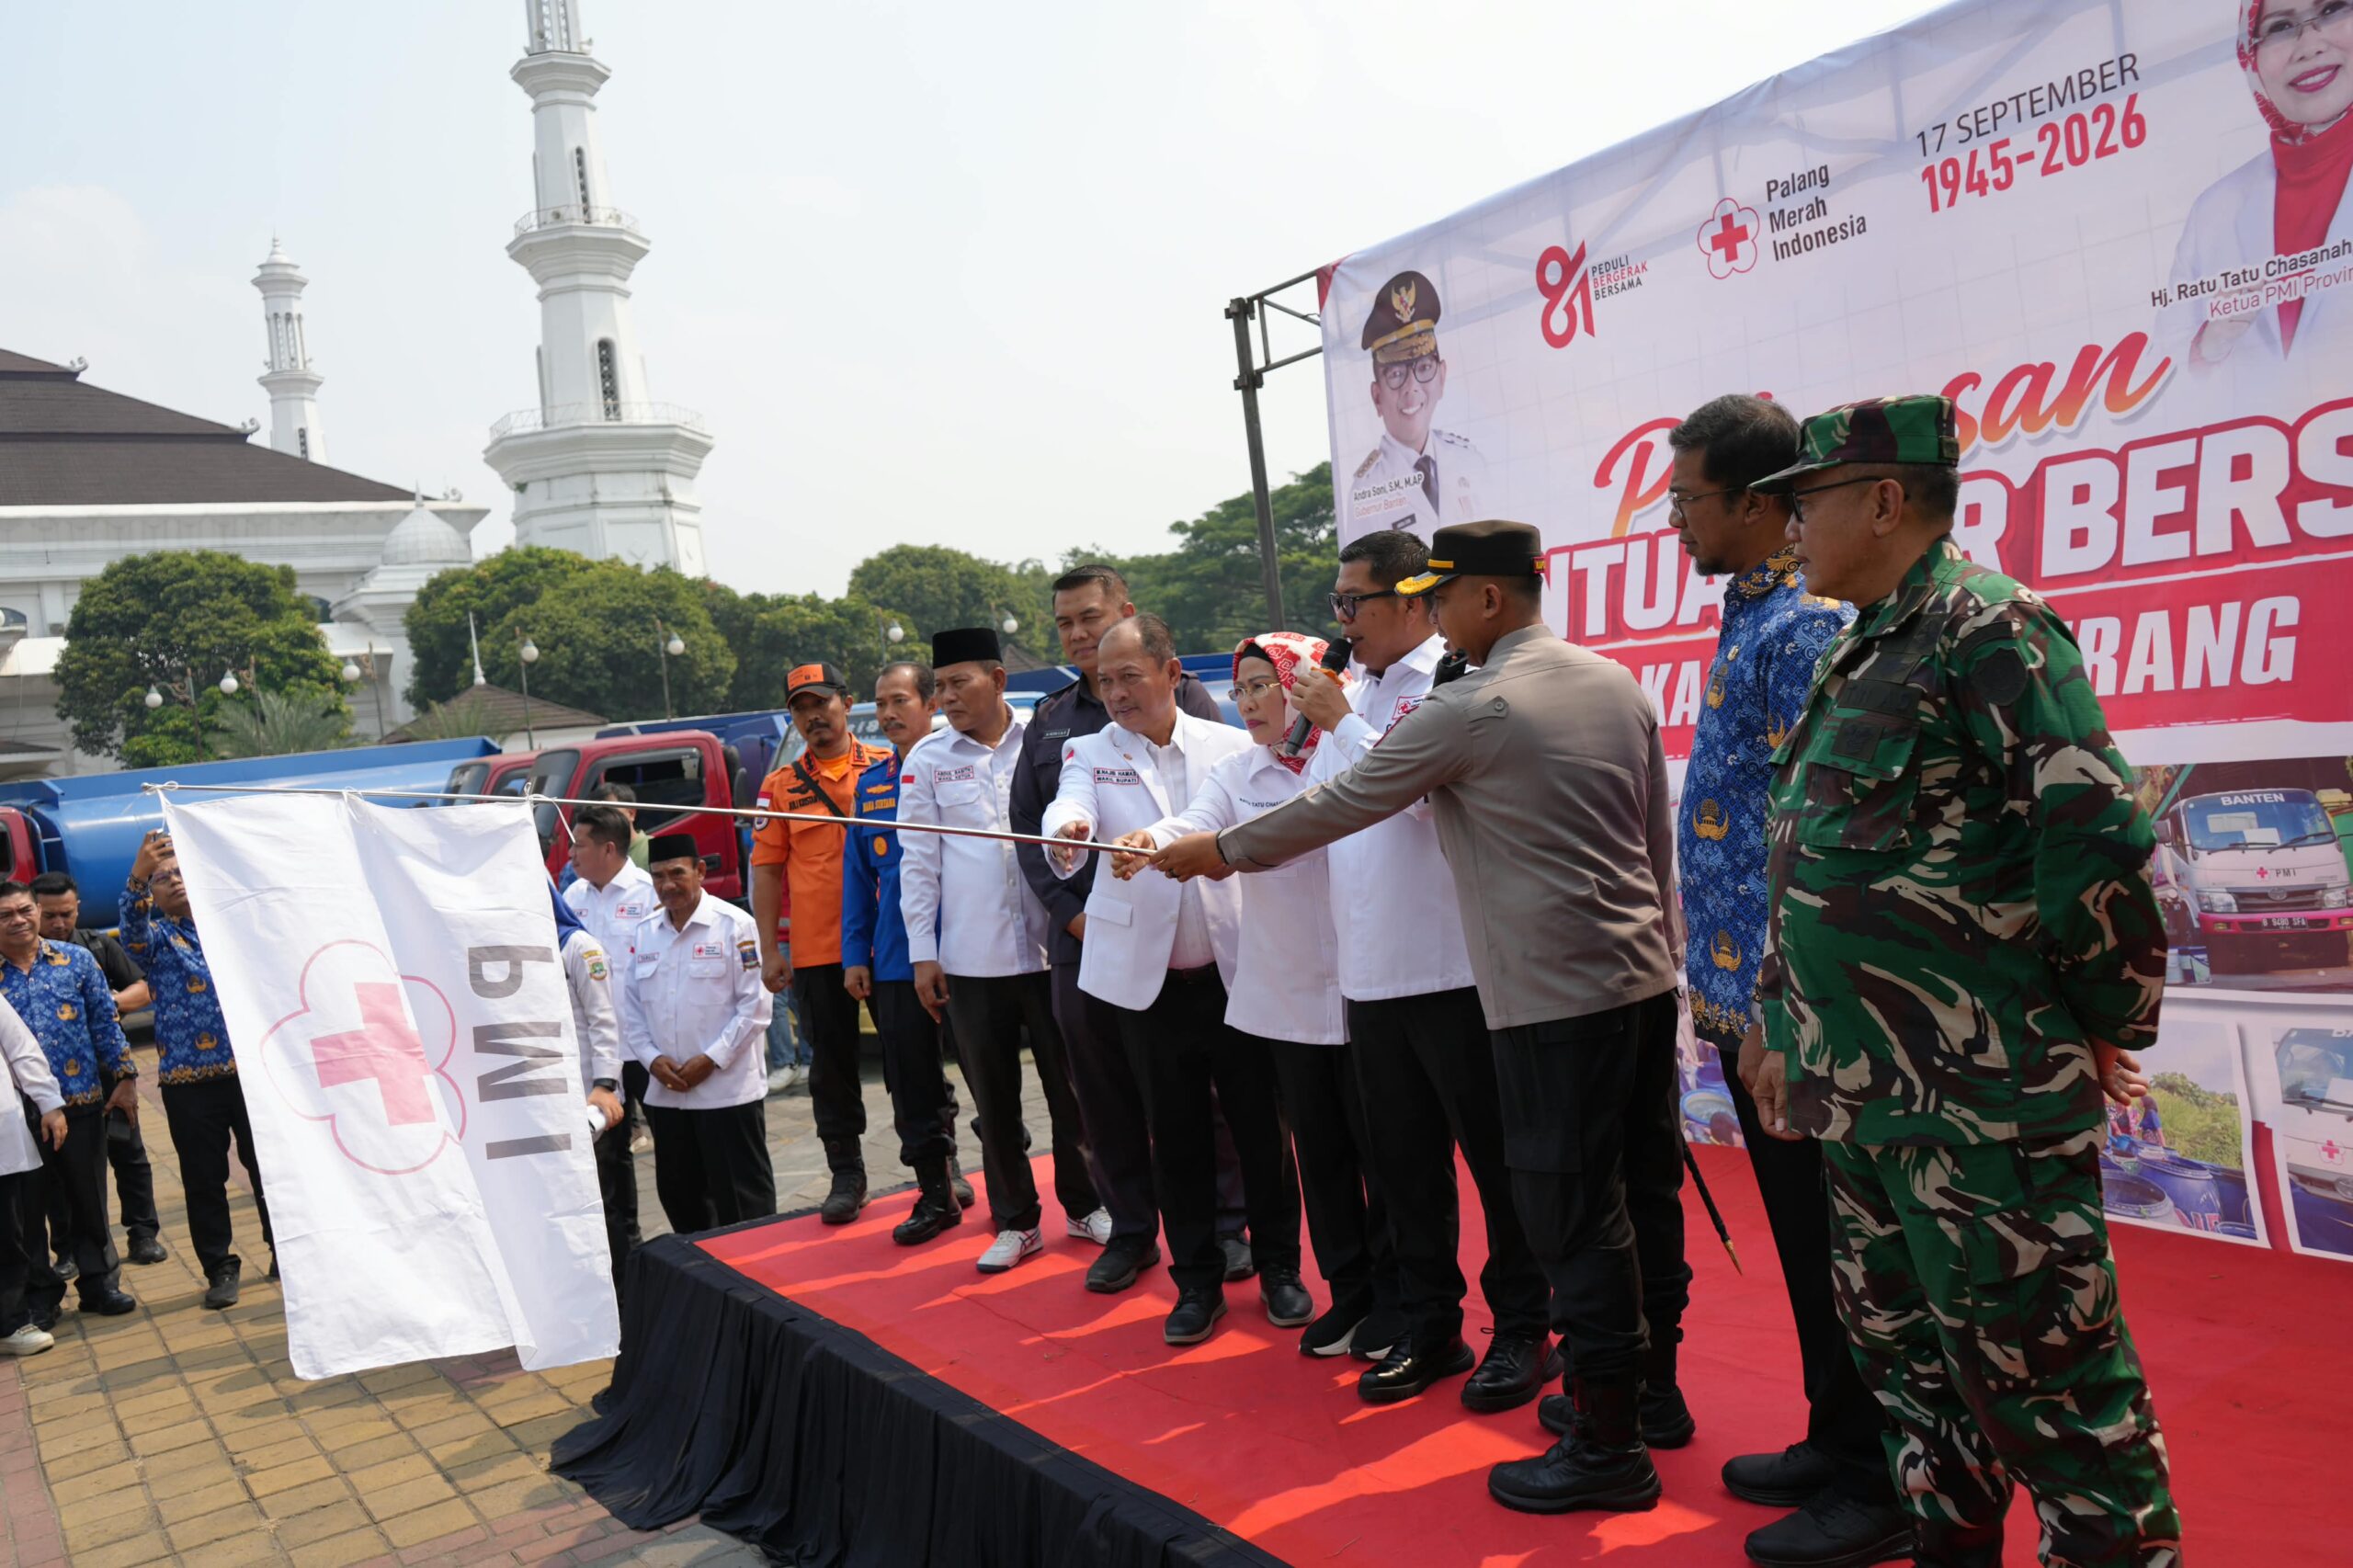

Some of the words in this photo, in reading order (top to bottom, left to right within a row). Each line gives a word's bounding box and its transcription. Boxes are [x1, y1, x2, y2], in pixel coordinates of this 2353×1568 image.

[1916, 123, 1947, 157] 17
[1957, 53, 2139, 144] SEPTEMBER
[1921, 93, 2146, 213] 1945-2026
[1767, 165, 1830, 202] Palang
[1769, 196, 1827, 233] Merah
[1773, 214, 1867, 261] Indonesia
[1591, 255, 1630, 277] PEDULI
[1593, 261, 1648, 289] BERGERAK
[1595, 276, 1643, 301] BERSAMA
[2151, 289, 2174, 307] Hj.
[2177, 278, 2217, 301] Ratu
[2221, 267, 2259, 289] Tatu
[2210, 294, 2260, 318] Ketua
[2266, 279, 2298, 304] PMI
[1353, 490, 1371, 502] Andra
[2221, 792, 2285, 806] BANTEN
[2275, 869, 2296, 877] PMI
